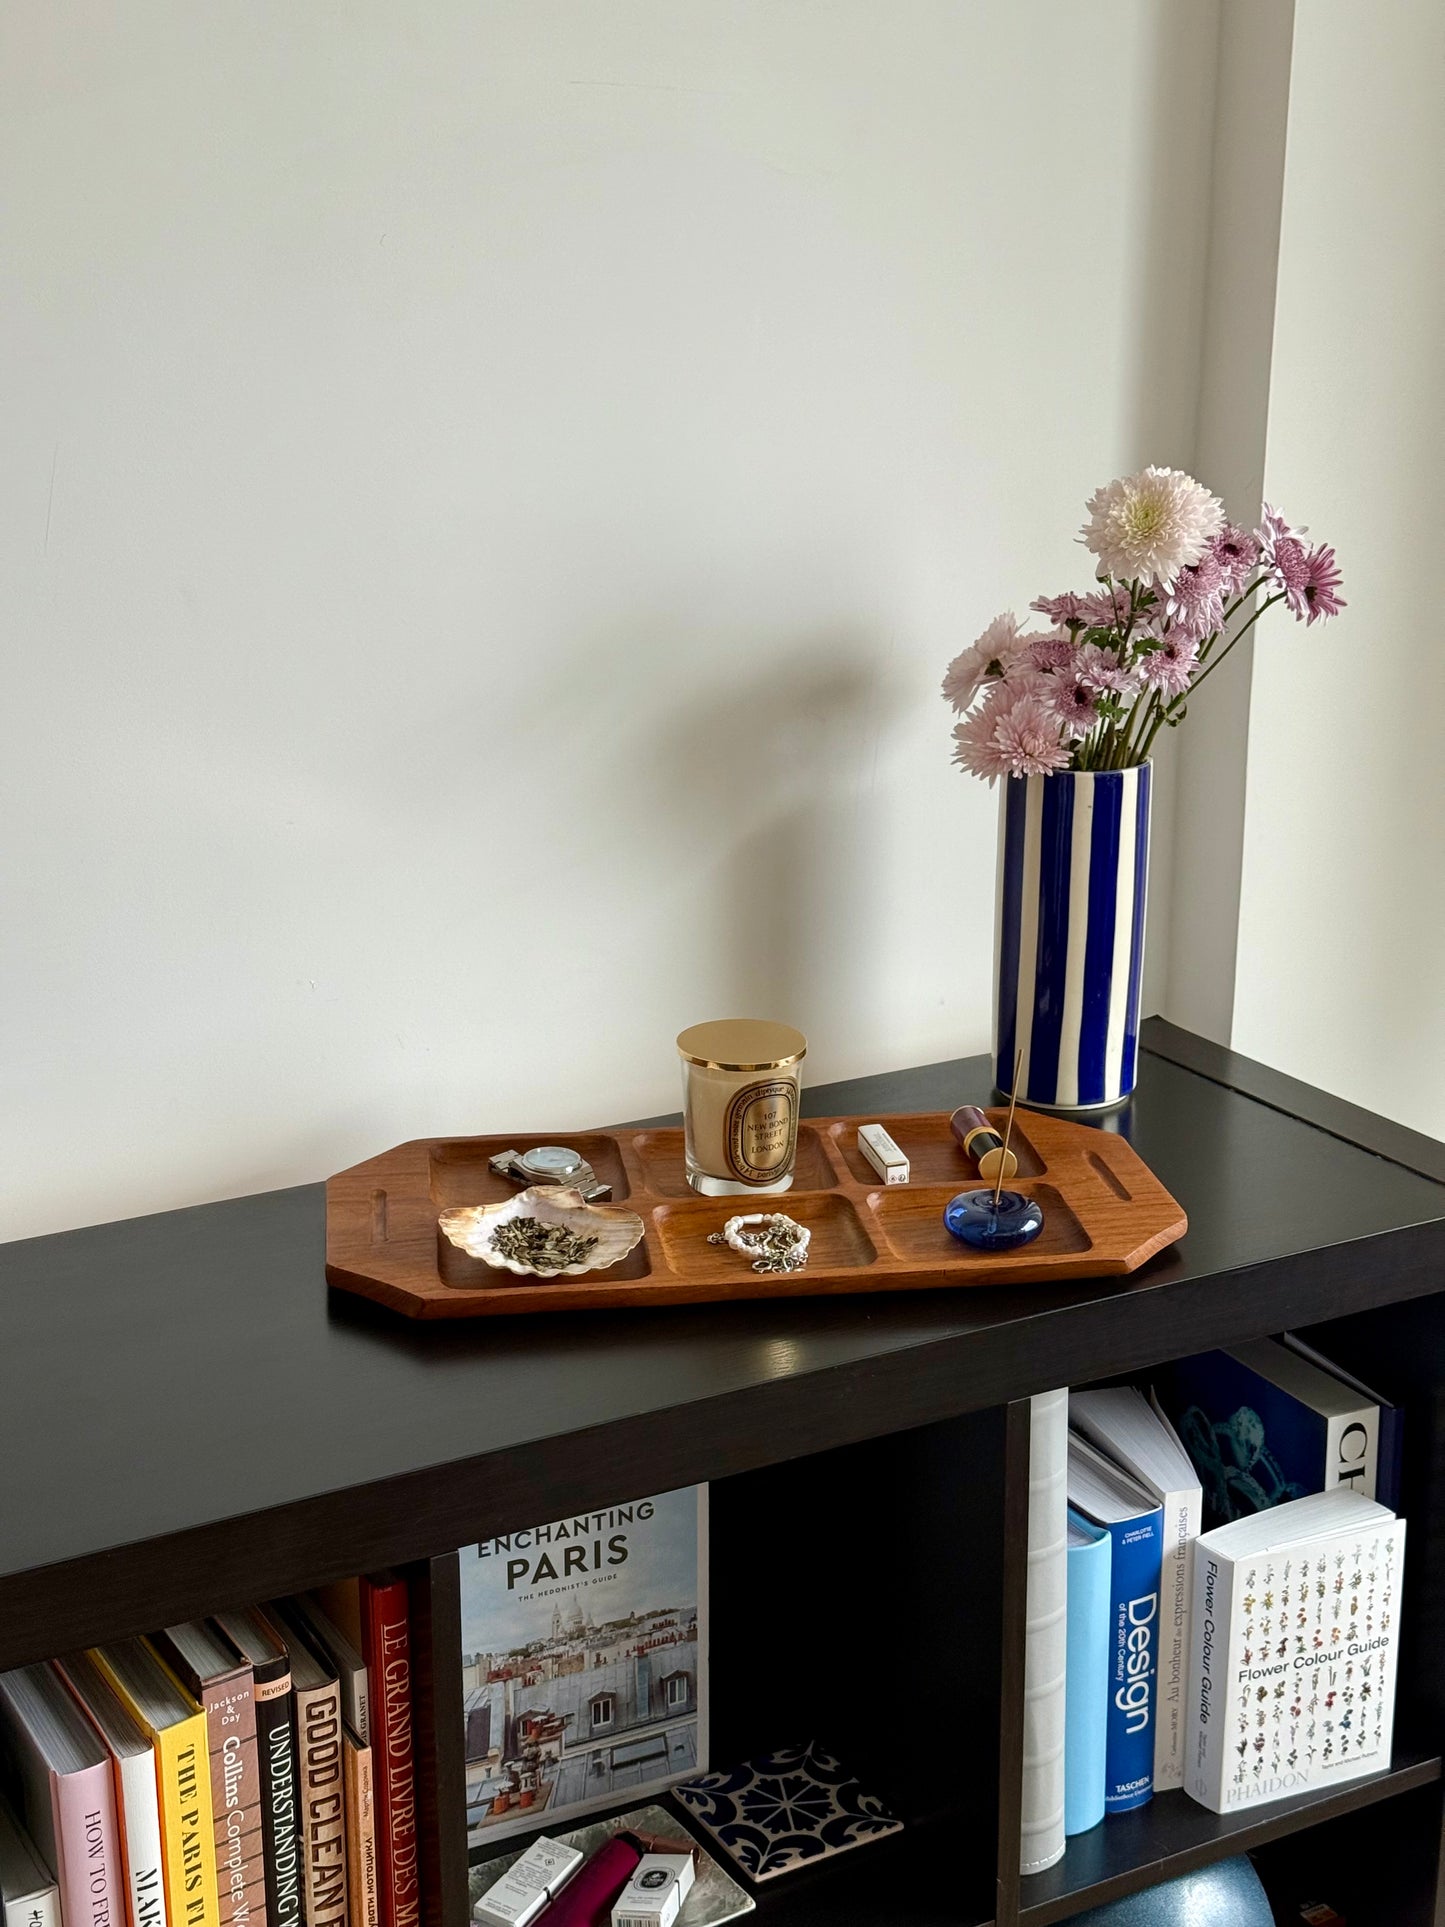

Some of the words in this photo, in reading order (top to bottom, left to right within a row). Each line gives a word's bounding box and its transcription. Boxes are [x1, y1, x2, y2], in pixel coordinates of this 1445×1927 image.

[748, 1121, 767, 1132] NEW
[769, 1117, 789, 1128] BOND
[754, 1129, 782, 1141] STREET
[764, 1111, 777, 1120] 107
[751, 1140, 784, 1154] LONDON
[478, 1501, 655, 1558] ENCHANTING
[1173, 1506, 1190, 1560] françaises
[507, 1534, 628, 1590] PARIS
[518, 1594, 534, 1602] THE
[538, 1581, 589, 1598] HEDONIST'S
[592, 1573, 617, 1585] GUIDE
[1118, 1602, 1127, 1612] of
[1172, 1563, 1187, 1627] expressions
[1205, 1560, 1218, 1617] Flower
[383, 1618, 408, 1655] LE
[1118, 1613, 1127, 1627] the
[1118, 1628, 1127, 1647] 20th
[1115, 1592, 1158, 1734] Design
[1115, 1649, 1126, 1682] Century
[1168, 1638, 1181, 1684] bonheur
[1202, 1619, 1215, 1675] Colour
[1238, 1662, 1289, 1683] Flower
[1293, 1649, 1344, 1670] Colour
[1347, 1636, 1390, 1656] Guide
[209, 1690, 250, 1713] Jackson
[226, 1705, 236, 1714] &
[261, 1681, 290, 1697] REVISED
[358, 1695, 367, 1729] GRANET
[385, 1659, 412, 1757] GRAND
[1168, 1687, 1179, 1703] Au
[1200, 1677, 1212, 1724] Guide
[221, 1713, 241, 1726] Day
[305, 1695, 340, 1789] GOOD
[177, 1743, 198, 1805] THE
[222, 1736, 244, 1807] Collins
[1115, 1776, 1150, 1793] TASCHEN
[1226, 1769, 1310, 1803] PHAIDON
[268, 1721, 299, 1914] UNDERSTANDING
[390, 1760, 416, 1841] LIVRE
[85, 1810, 105, 1859] HOW
[181, 1808, 203, 1892] PARIS
[223, 1809, 249, 1902] Complete
[309, 1792, 344, 1912] CLEAN
[89, 1862, 107, 1894] TO
[394, 1840, 418, 1894] DES
[231, 1902, 250, 1927] W
